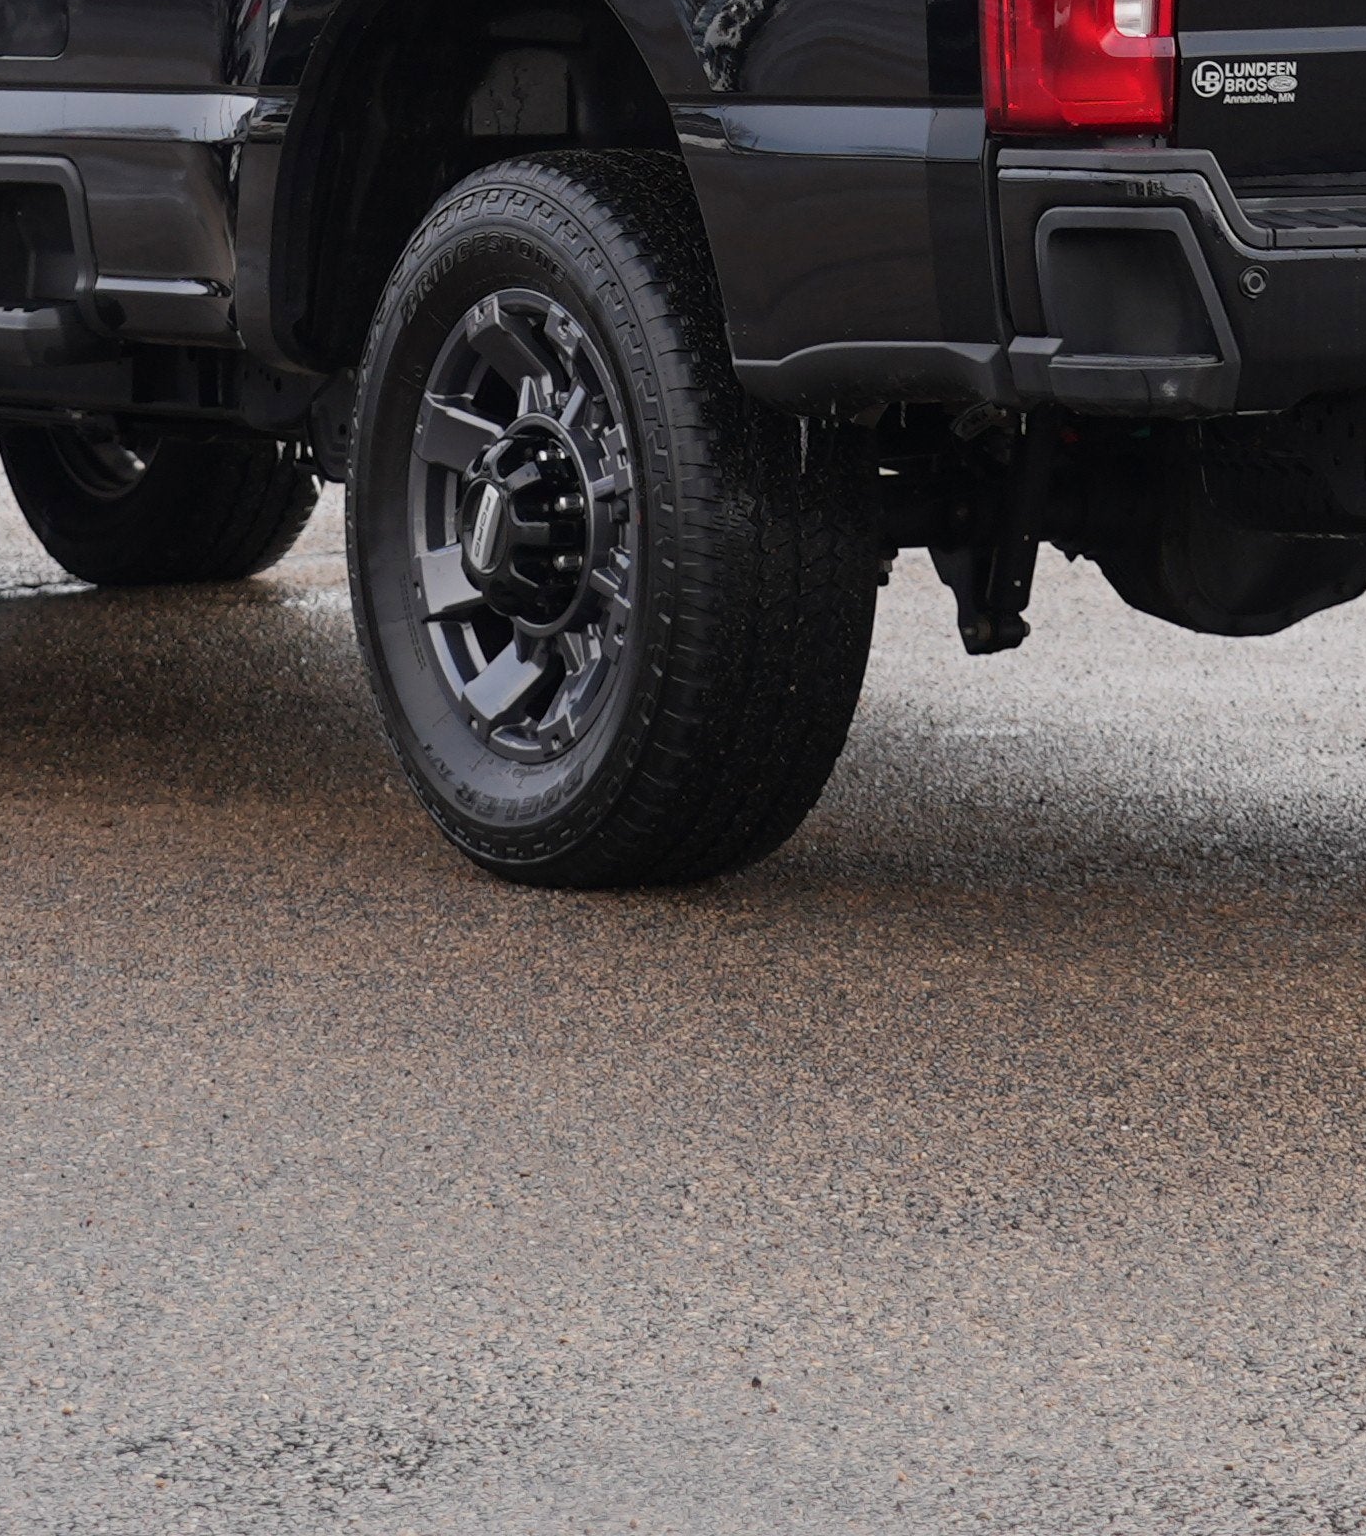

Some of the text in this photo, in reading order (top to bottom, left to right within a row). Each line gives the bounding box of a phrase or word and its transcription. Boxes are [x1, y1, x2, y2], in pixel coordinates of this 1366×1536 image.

[1224, 62, 1297, 77] LUNDEEN
[1225, 78, 1267, 93] BROS
[1223, 93, 1295, 104] Annandale, MN
[400, 230, 567, 326] BRIDGESTONE
